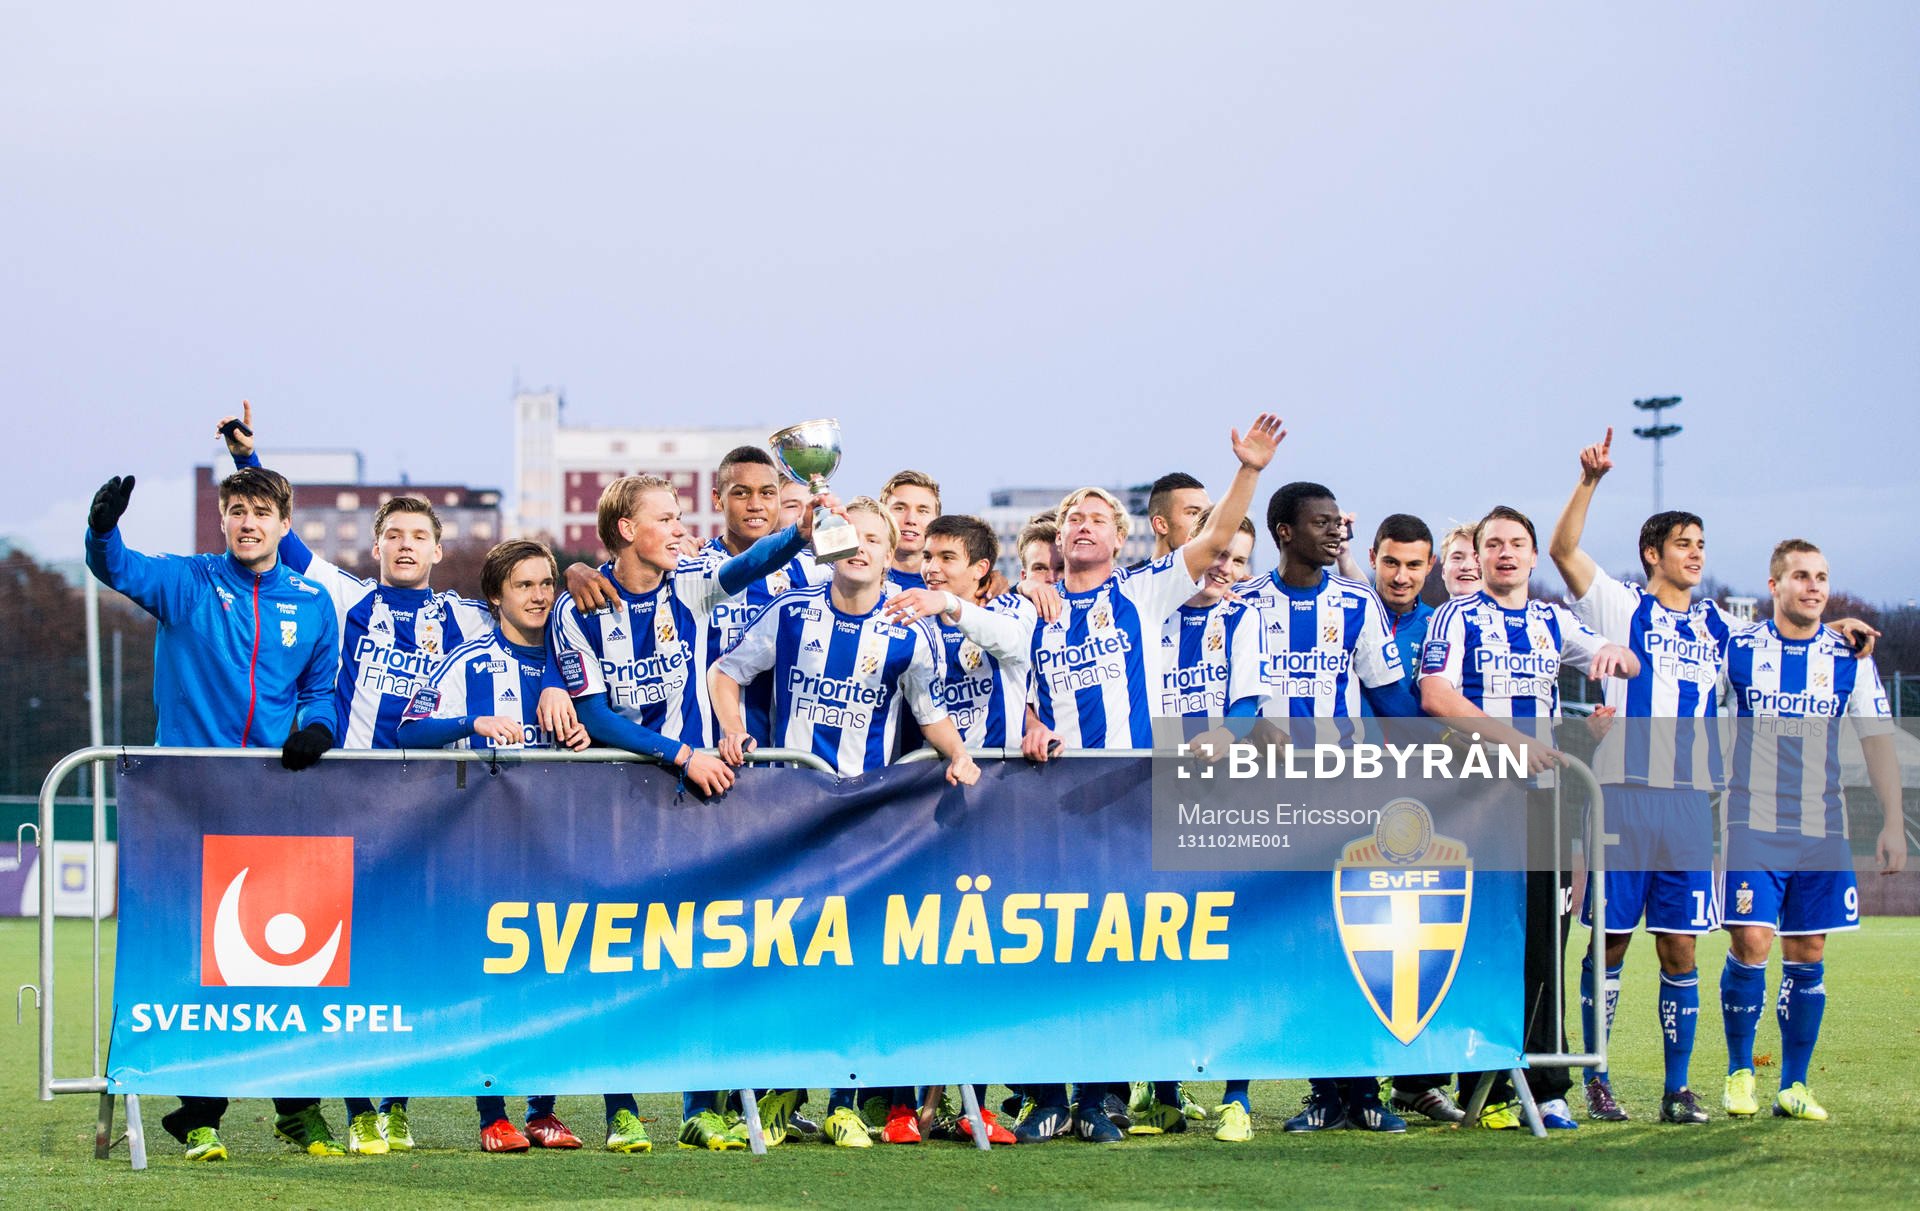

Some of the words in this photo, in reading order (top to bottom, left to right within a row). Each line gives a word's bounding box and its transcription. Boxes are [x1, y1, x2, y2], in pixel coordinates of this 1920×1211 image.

[631, 601, 655, 609] Prioritet
[607, 634, 627, 642] adidas
[1037, 631, 1129, 673] Prioritet
[357, 638, 441, 676] Priorite
[485, 659, 506, 667] INTER
[600, 644, 690, 682] Prioritet
[1271, 650, 1347, 671] rioritet
[363, 666, 424, 697] Finan
[615, 675, 684, 705] Finans
[790, 668, 886, 706] Prioritet
[1051, 663, 1121, 694] Finans
[1163, 663, 1228, 689] riorite
[1491, 674, 1550, 696] Finans
[795, 697, 867, 729] Finans
[1161, 691, 1226, 715] Finans
[1748, 689, 1840, 716] Prioritet
[1758, 713, 1824, 737] Finans
[1369, 870, 1440, 889] SvFF
[1844, 886, 1859, 921] 9
[483, 896, 854, 974] SVENSKA
[883, 874, 1235, 965] MÄSTARE
[131, 1003, 307, 1033] SVENSKA
[321, 1003, 413, 1033] SPEL
